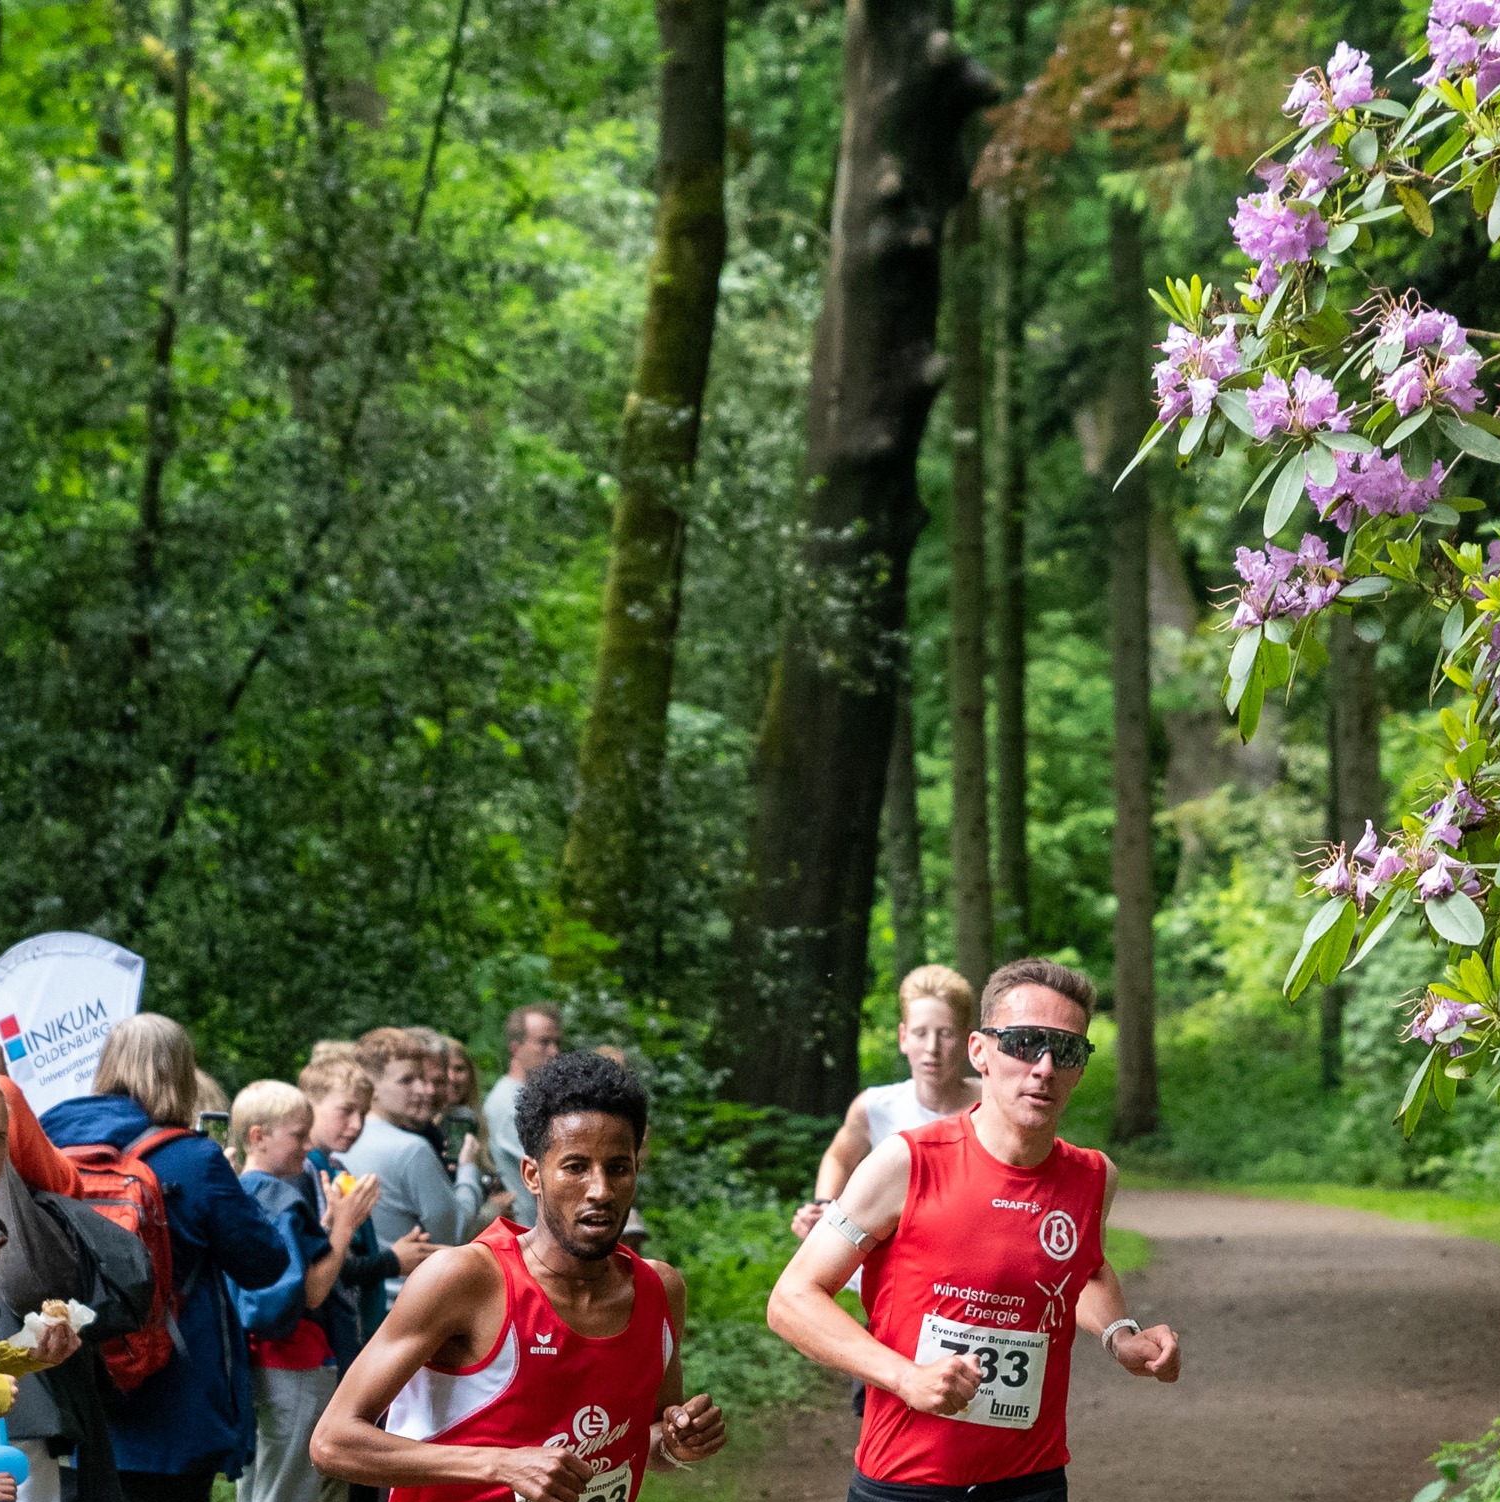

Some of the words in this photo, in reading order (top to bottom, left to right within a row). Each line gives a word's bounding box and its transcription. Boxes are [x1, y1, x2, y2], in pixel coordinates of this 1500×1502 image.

[34, 1022, 111, 1069] OLDENBURG
[991, 1198, 1031, 1212] CRAFT
[933, 1282, 1026, 1308] windstream
[964, 1303, 1021, 1325] Energie
[931, 1324, 986, 1342] Everstener
[988, 1335, 1044, 1349] Brunnenlauf
[529, 1345, 558, 1355] erima
[989, 1398, 1030, 1419] bruns
